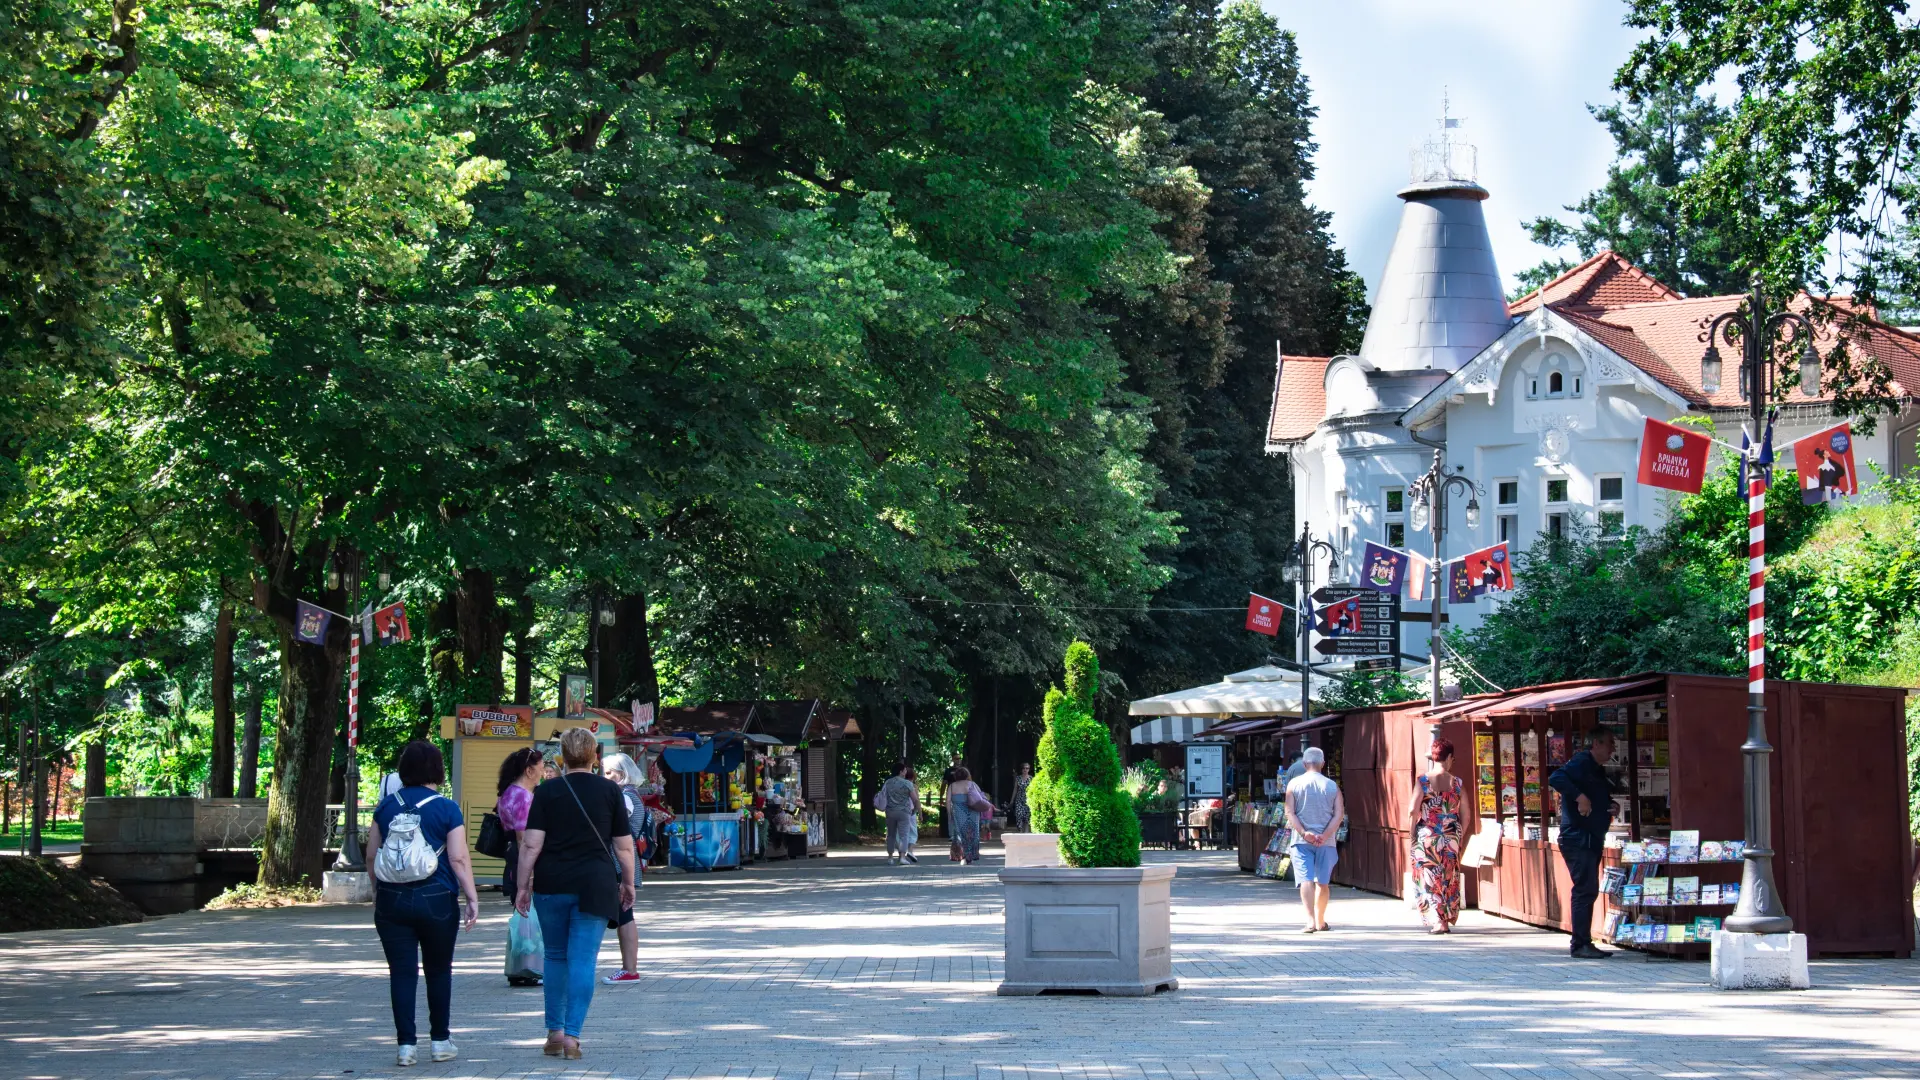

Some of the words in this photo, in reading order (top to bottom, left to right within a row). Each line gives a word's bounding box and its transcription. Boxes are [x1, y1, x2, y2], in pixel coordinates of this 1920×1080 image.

[1658, 453, 1688, 467] ВРНАЧКИ
[1652, 462, 1690, 478] КАРНЕВАЛ
[472, 709, 518, 724] BUBBLE
[491, 724, 517, 736] TEA
